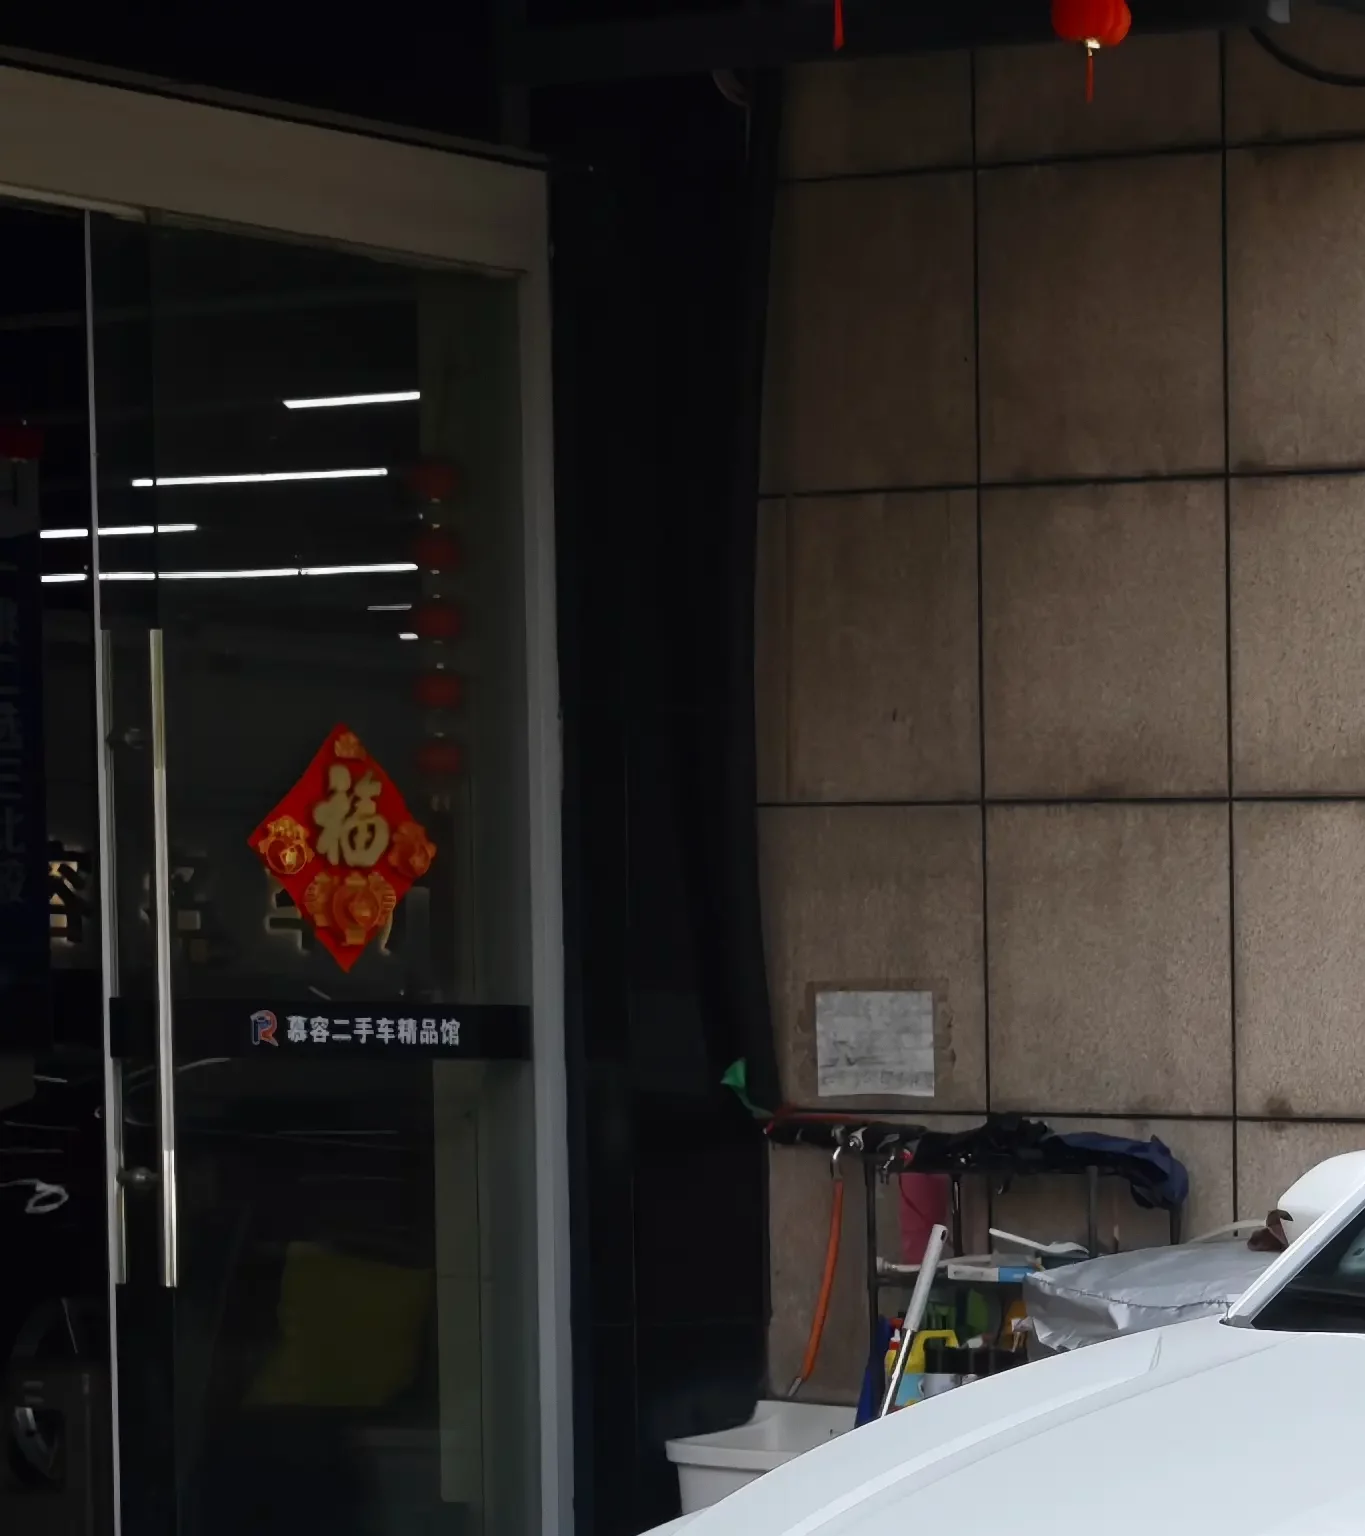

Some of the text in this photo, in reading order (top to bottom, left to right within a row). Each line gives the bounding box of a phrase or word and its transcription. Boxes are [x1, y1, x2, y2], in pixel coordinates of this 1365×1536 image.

[313, 764, 390, 868] 福
[286, 1015, 461, 1046] 慕容二手车精品馆
